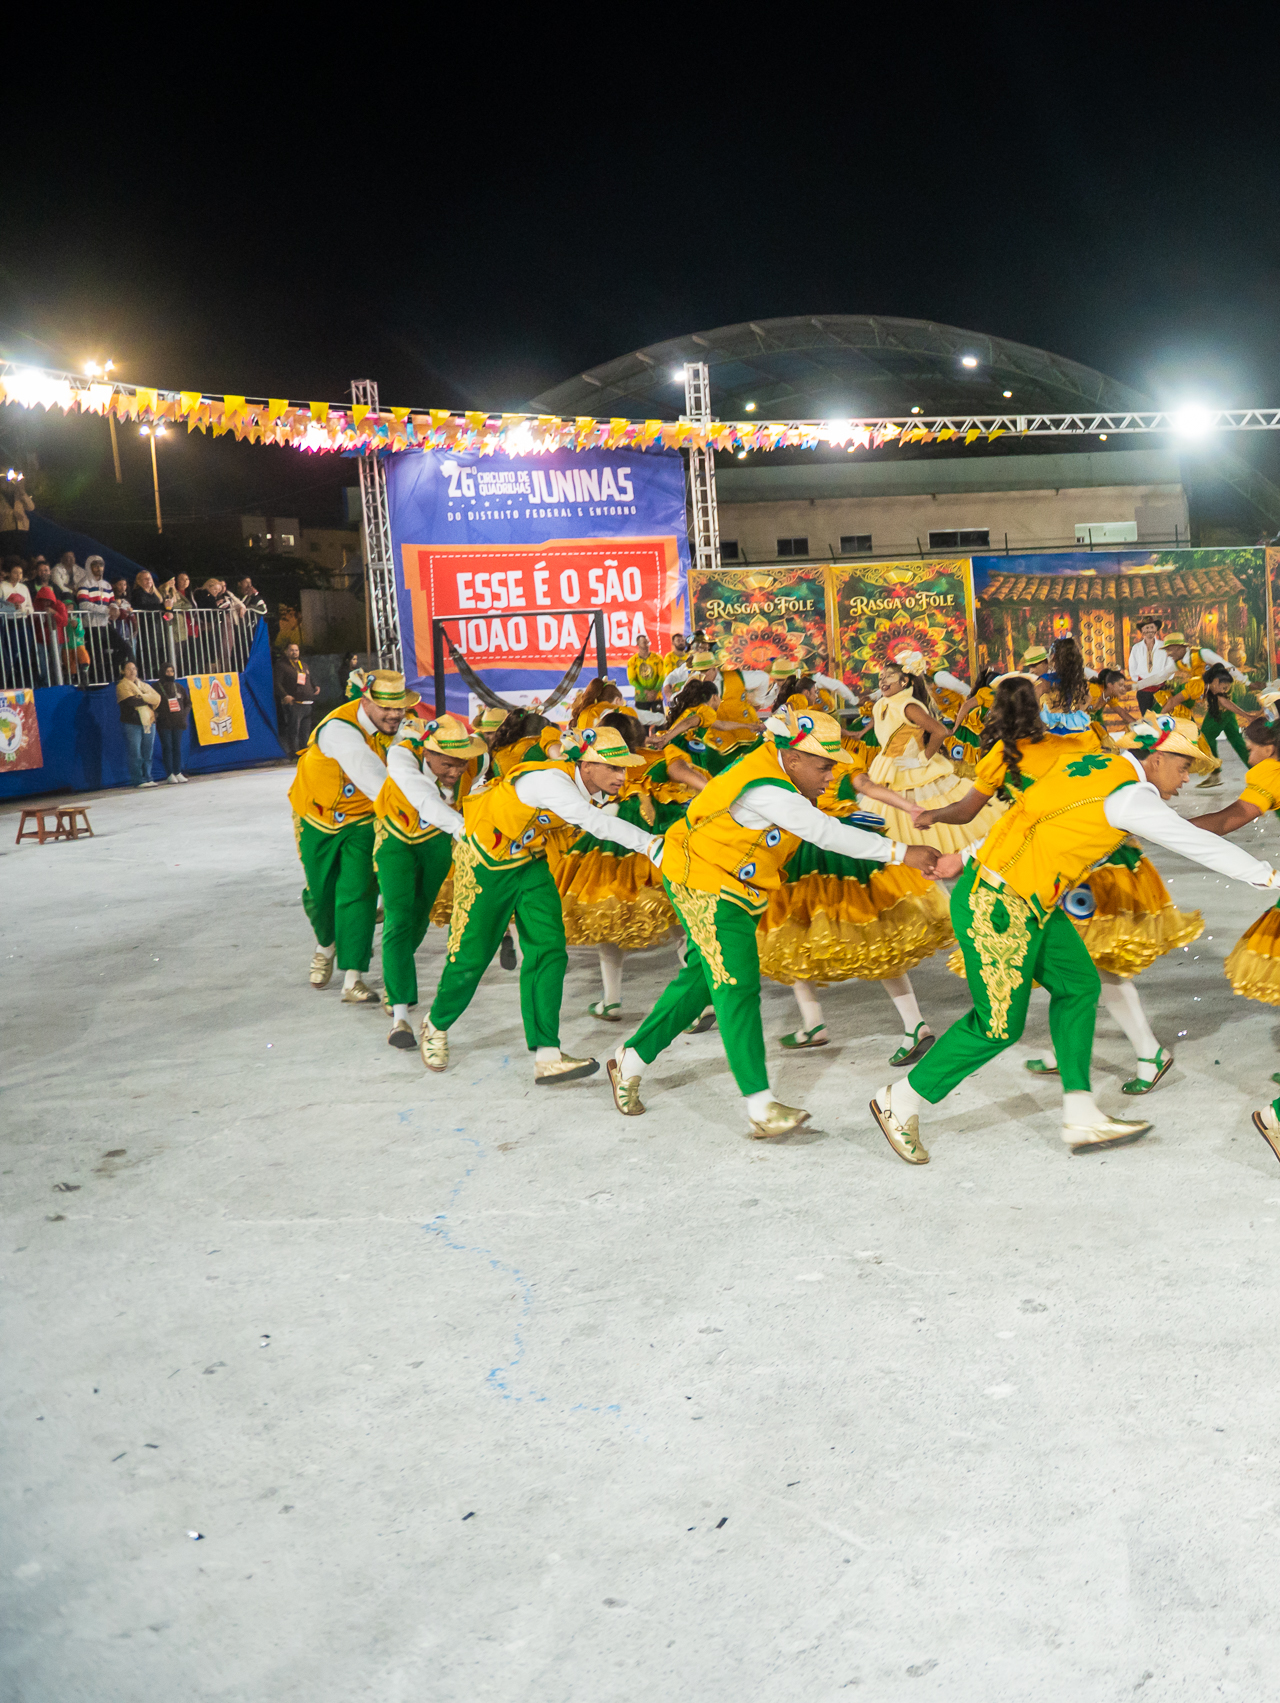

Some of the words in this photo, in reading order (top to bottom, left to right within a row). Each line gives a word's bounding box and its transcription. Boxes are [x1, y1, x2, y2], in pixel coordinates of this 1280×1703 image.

[477, 471, 516, 484] CIRCUITO
[517, 470, 530, 483] DE
[479, 482, 532, 496] QUADRILHAS
[528, 466, 635, 504] JUNINAS
[447, 512, 461, 521] DO
[467, 510, 519, 520] DISTRITO
[525, 508, 572, 519] FEDERAL
[577, 507, 583, 517] E
[589, 505, 637, 517] ENTORNO
[456, 570, 526, 609] ESSE
[533, 561, 551, 605] É
[560, 569, 580, 604] O
[588, 559, 643, 604] SÃO
[706, 600, 760, 620] RASGA
[774, 596, 815, 616] FOLE
[849, 595, 902, 617] RASGA
[915, 590, 955, 611] FOLE
[453, 609, 529, 655] JOÃO
[536, 614, 581, 651] DA
